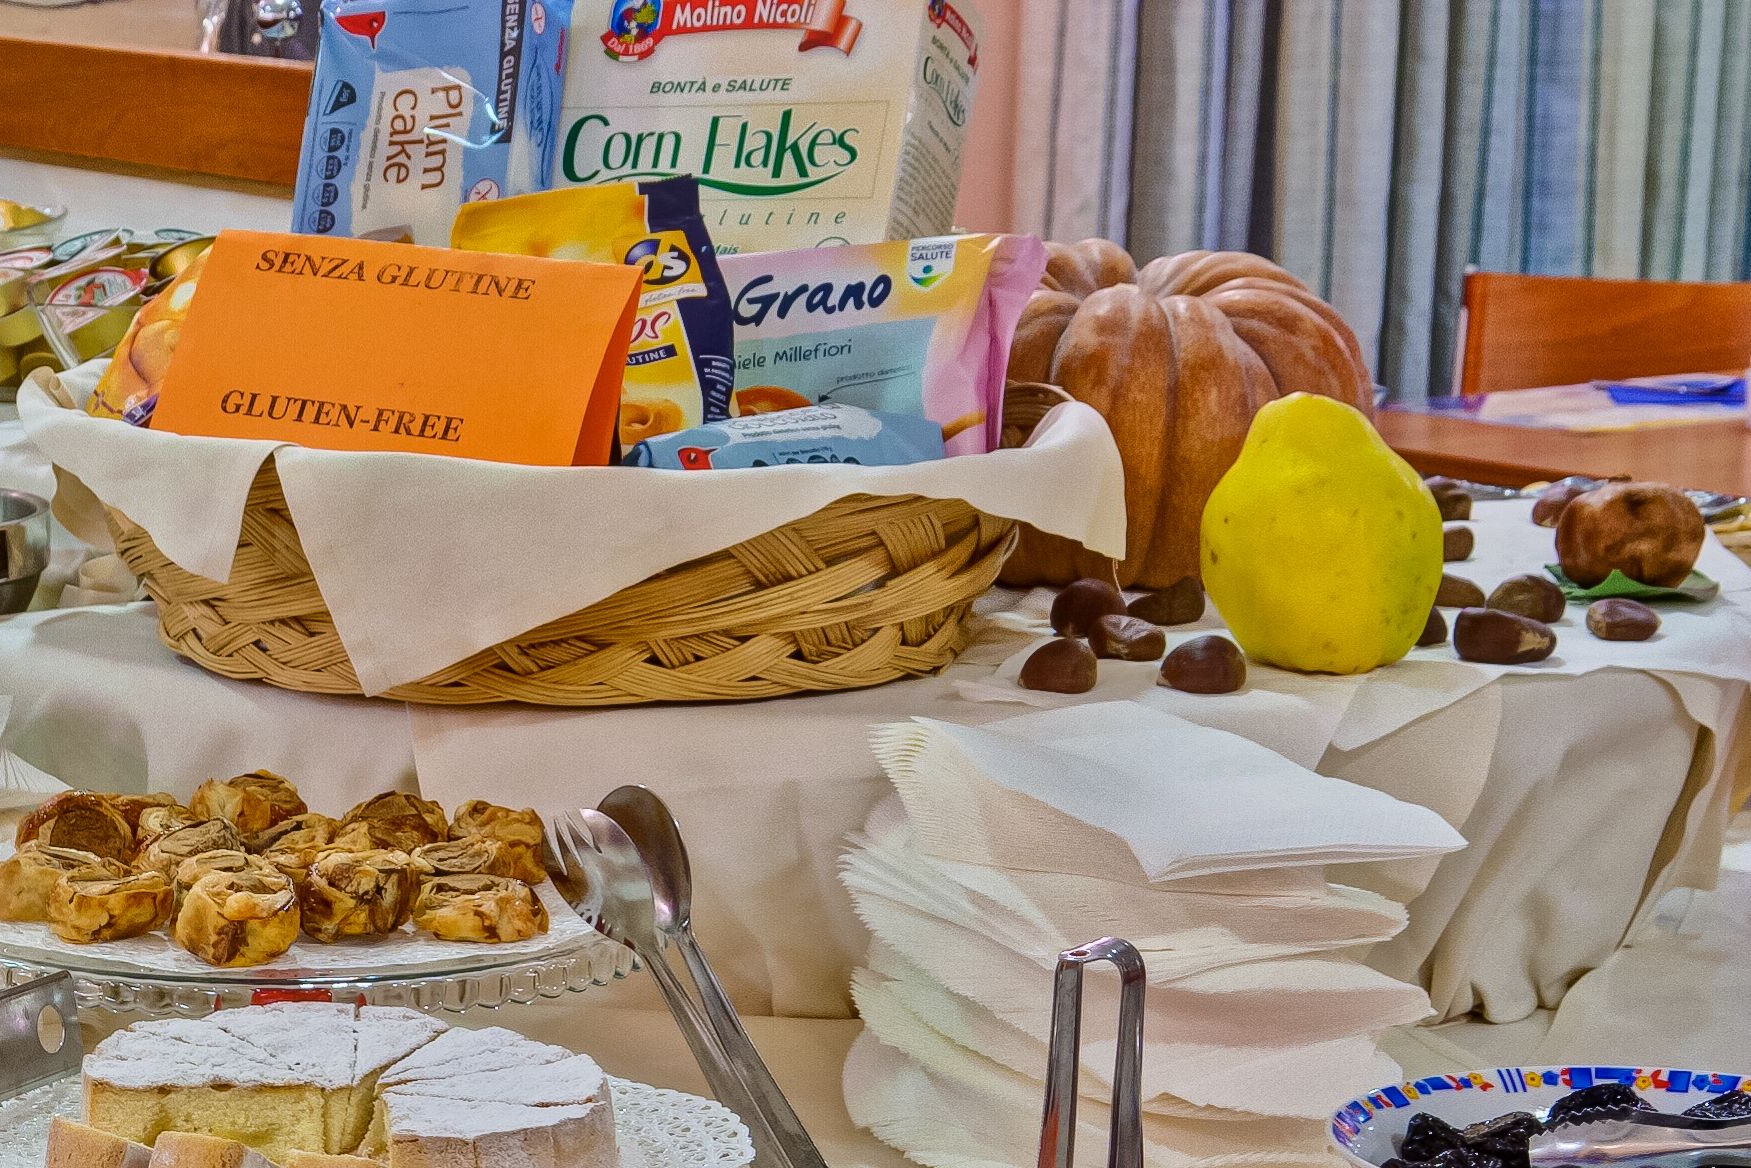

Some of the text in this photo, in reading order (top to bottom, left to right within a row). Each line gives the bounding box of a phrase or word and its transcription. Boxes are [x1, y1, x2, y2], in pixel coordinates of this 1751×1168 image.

[672, 0, 816, 30] Molino Nicoli
[650, 77, 707, 94] BONTÀ
[725, 77, 793, 93] SALUTE
[382, 88, 425, 185] cake
[561, 114, 683, 183] Corn
[701, 107, 861, 179] Flakes
[718, 207, 847, 226] lutine
[255, 249, 537, 300] SENZA GLUTINE
[910, 251, 953, 262] SALUTE
[733, 273, 893, 327] Grano
[773, 339, 852, 366] Millefiori
[219, 389, 466, 443] GLUTEN-FREE
